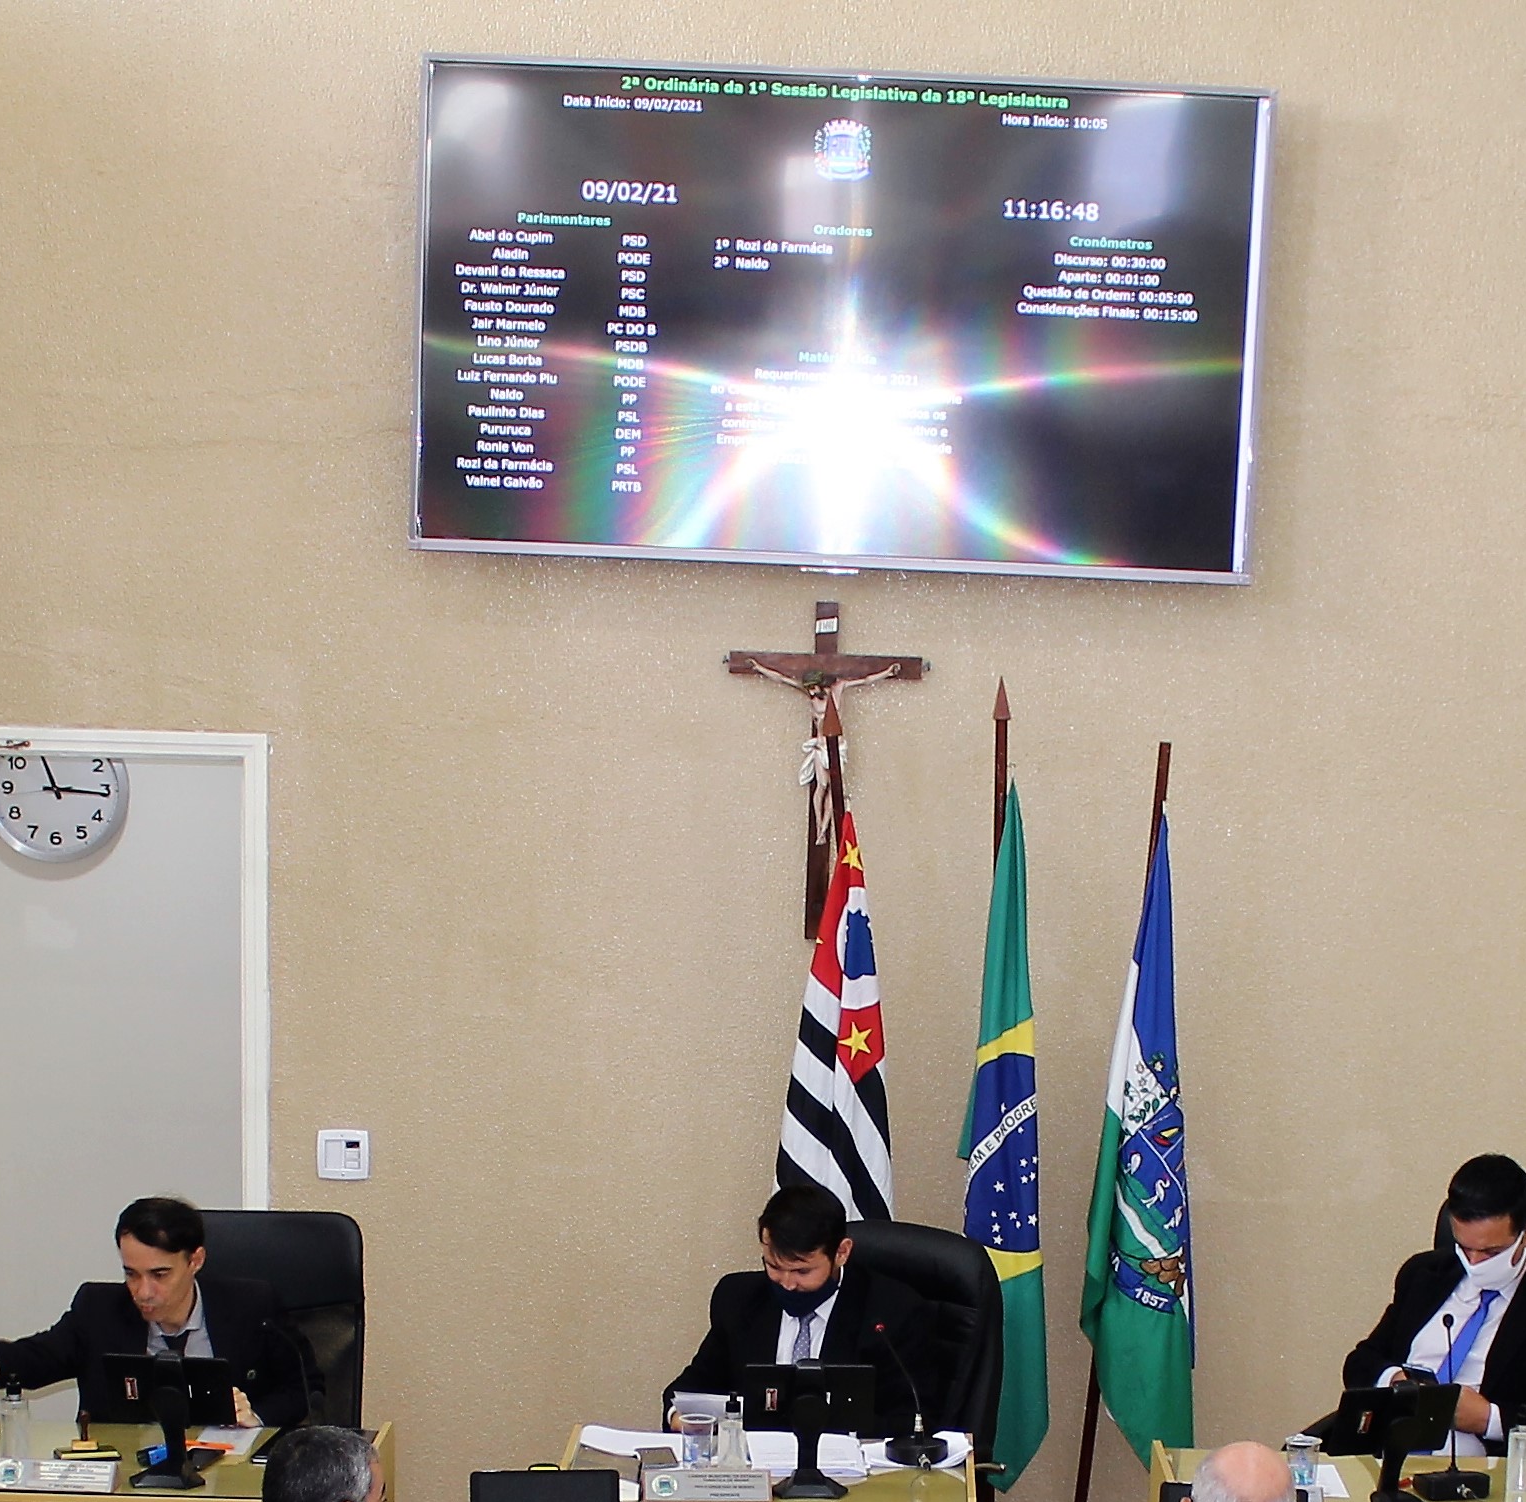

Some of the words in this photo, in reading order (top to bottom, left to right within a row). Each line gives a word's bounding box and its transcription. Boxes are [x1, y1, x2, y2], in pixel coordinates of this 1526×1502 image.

[644, 76, 720, 95] Ordinária
[722, 80, 743, 94] da
[770, 81, 829, 99] Sessão
[831, 84, 918, 103] Legislativa
[921, 87, 942, 103] da
[979, 91, 1070, 110] Legislatura
[563, 94, 590, 108] Data
[593, 95, 631, 110] Início:
[634, 97, 704, 114] 09/02/2021
[1001, 113, 1030, 127] Hora
[1032, 113, 1070, 129] Início:
[1073, 115, 1108, 130] 10:05
[581, 179, 678, 205] 09/02/21
[1003, 198, 1100, 222] 11:16:48
[517, 212, 612, 227] Parlamentares
[469, 228, 496, 241] Abel
[497, 229, 513, 242] do
[516, 230, 554, 245] Cupim
[813, 224, 873, 237] Oradores
[622, 234, 647, 248] PSD
[763, 239, 779, 252] da
[781, 241, 833, 255] Farmácia
[1069, 236, 1153, 251] Cronômetros
[492, 247, 529, 260] Aladin
[617, 252, 651, 265] PODE
[735, 257, 770, 270] Naldo
[1054, 253, 1108, 267] Discurso:
[1111, 256, 1167, 270] 00:30:00
[455, 263, 499, 276] Devanil
[501, 265, 516, 277] da
[519, 266, 565, 279] Ressaca
[621, 270, 646, 283] PSD
[1058, 270, 1102, 285] Aparte:
[1104, 272, 1160, 287] 00:01:00
[461, 282, 478, 294] Dr.
[523, 282, 560, 296] Júnior
[621, 288, 646, 300] PSC
[1023, 285, 1072, 300] Questão
[1074, 287, 1089, 299] de
[1091, 288, 1136, 303] Ordem:
[1138, 291, 1193, 305] 00:05:00
[464, 300, 503, 312] Fausto
[505, 300, 555, 314] Dourado
[618, 305, 646, 318] MDB
[1017, 302, 1100, 319] Considerações
[1102, 306, 1140, 320] Finais:
[1143, 307, 1198, 322] 00:15:00
[471, 317, 494, 330] Jair
[496, 318, 546, 331] Marmelo
[607, 322, 626, 335] PC
[626, 322, 645, 336] DO
[647, 322, 657, 336] B
[477, 335, 502, 347] Lino
[504, 334, 540, 349] Júnior
[615, 341, 648, 353] PSDB
[473, 352, 506, 365] Lucas
[508, 353, 543, 366] Borba
[617, 358, 645, 370] MDB
[457, 369, 481, 382] Luiz
[483, 370, 537, 383] Fernando
[539, 372, 558, 384] Piu
[614, 375, 646, 388] PODE
[890, 373, 919, 386] 2021
[490, 388, 524, 401] Naldo
[622, 393, 637, 405] PP
[468, 405, 517, 418] Paulinho
[519, 407, 545, 419] Dias
[617, 411, 640, 423] PSL
[932, 411, 948, 421] os
[480, 423, 532, 436] Pururuca
[615, 428, 642, 440] DEM
[940, 427, 949, 438] e
[476, 440, 510, 453] Ronie
[512, 441, 535, 454] Von
[620, 446, 636, 458] PP
[457, 457, 481, 469] Rozi
[483, 458, 499, 470] da
[501, 459, 553, 472] Farmácia
[616, 463, 639, 476] PSL
[503, 476, 543, 489] Galvão
[611, 480, 642, 493] PRTB
[7, 756, 26, 770] 10
[92, 759, 104, 772] 2
[1, 780, 14, 795] 9
[100, 783, 111, 797] 3
[8, 806, 21, 819] 8
[91, 809, 103, 823] 4
[27, 825, 39, 840] 7
[49, 831, 62, 845] 6
[76, 825, 88, 840] 5
[984, 1141, 995, 1152] E
[993, 1097, 1037, 1143] PROGRE
[1135, 1287, 1169, 1309] 1857
